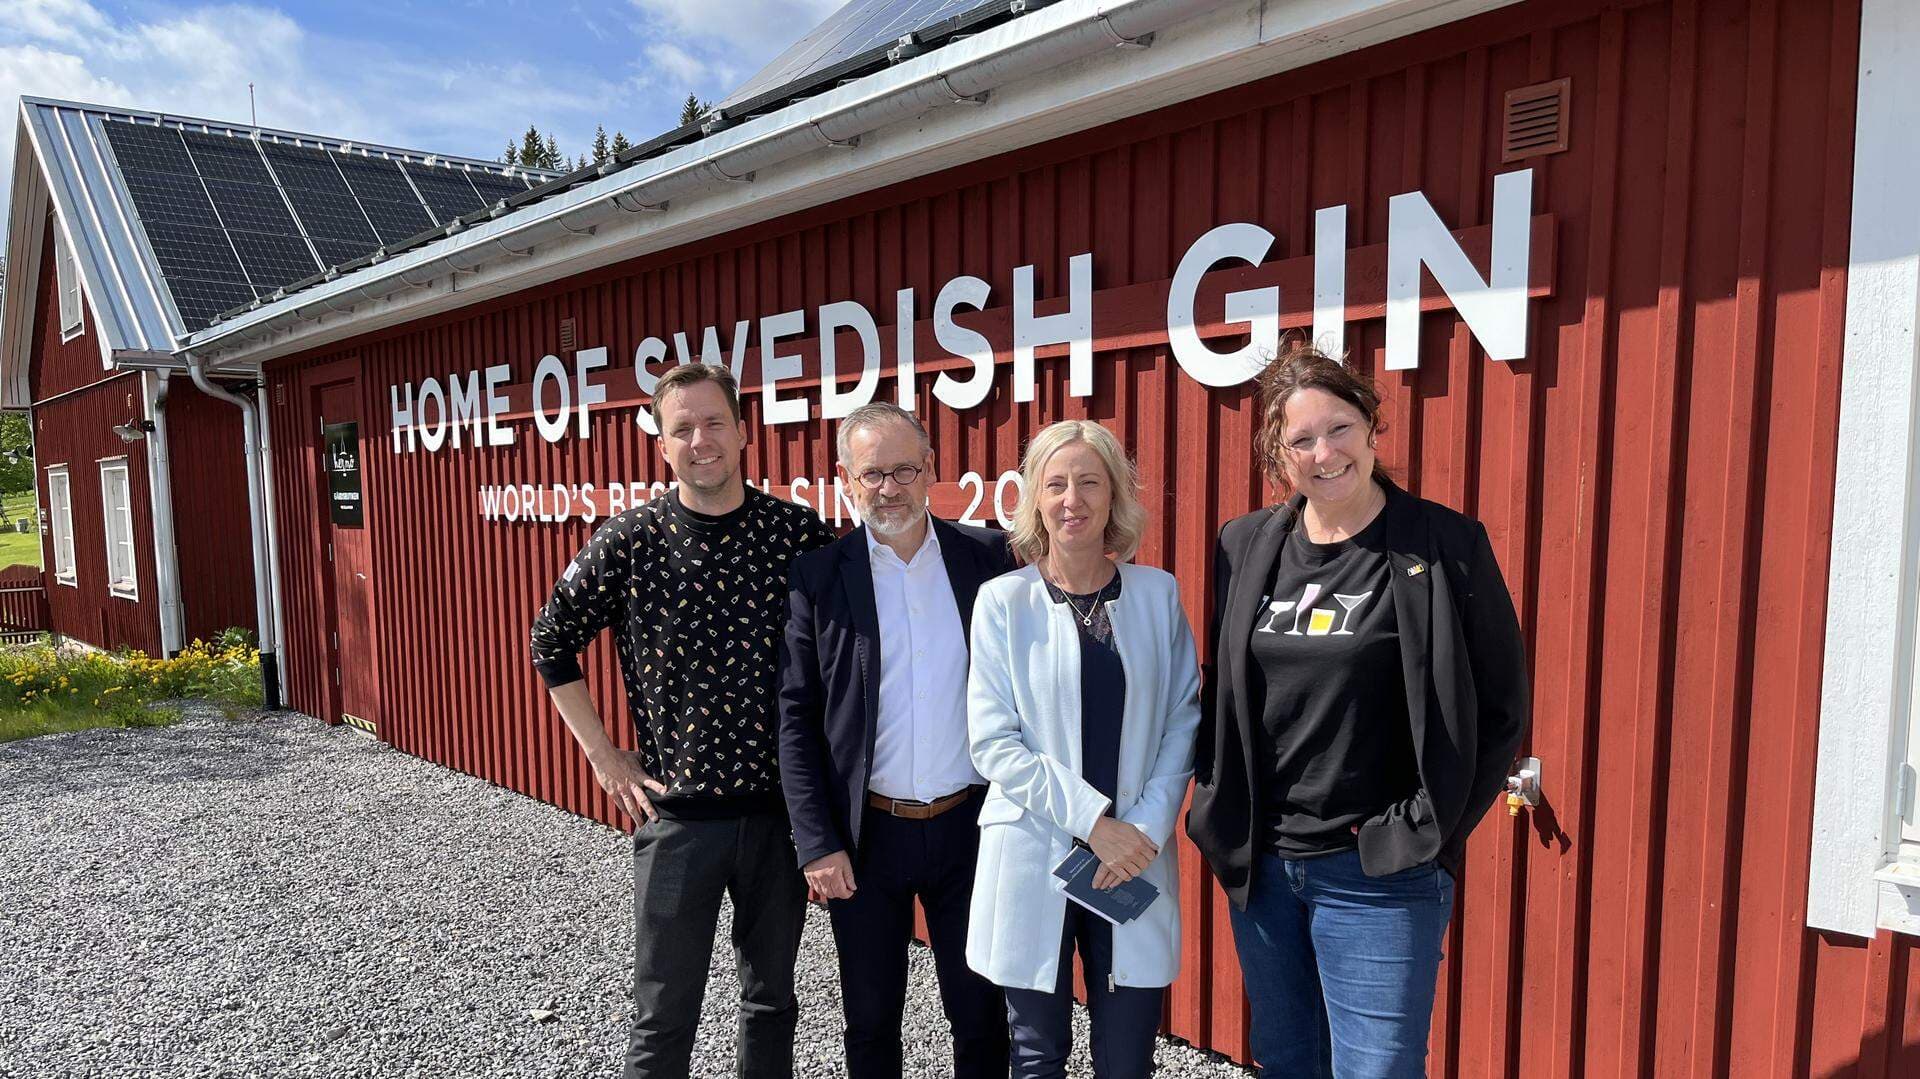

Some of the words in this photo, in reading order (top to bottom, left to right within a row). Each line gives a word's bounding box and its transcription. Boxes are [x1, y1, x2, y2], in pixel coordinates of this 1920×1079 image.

[390, 364, 514, 454] HOME
[532, 346, 608, 443] OF
[1167, 168, 1533, 388] GIN
[480, 482, 596, 524] WORLD'S
